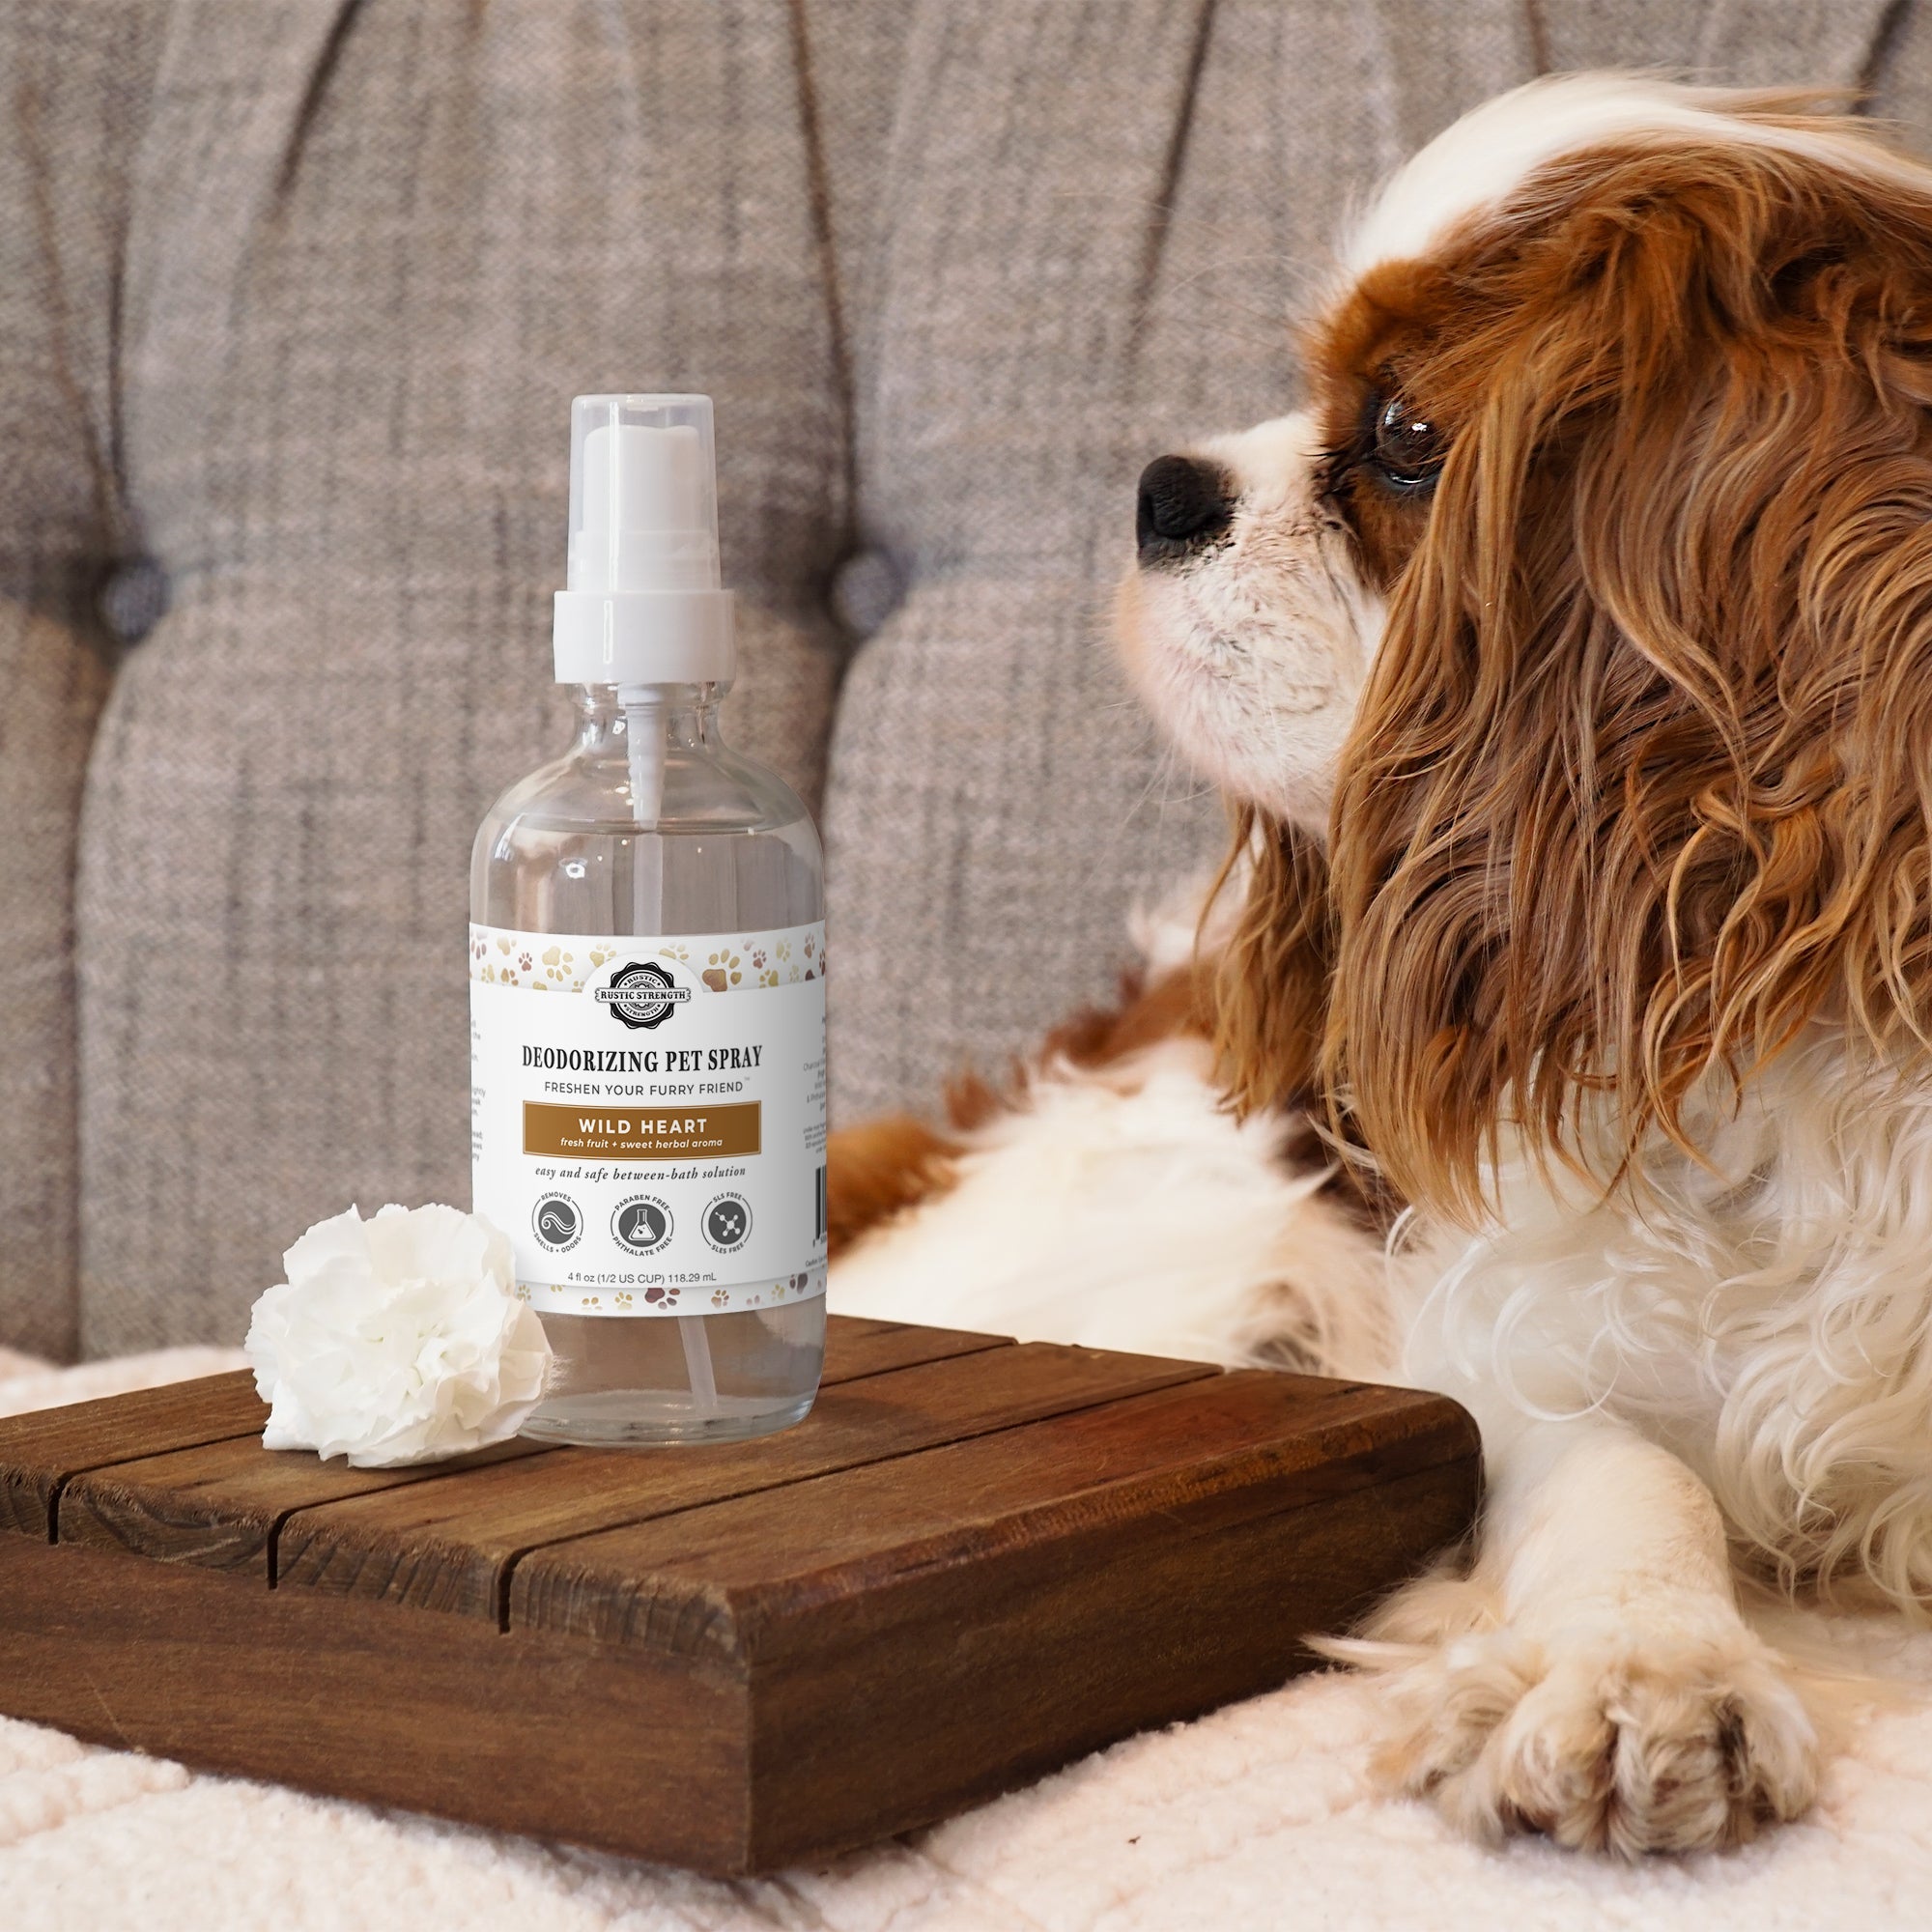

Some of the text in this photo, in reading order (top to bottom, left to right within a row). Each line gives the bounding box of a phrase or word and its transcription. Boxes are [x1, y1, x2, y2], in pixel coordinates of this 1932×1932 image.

[627, 975, 658, 984] RUSTIC
[601, 991, 686, 1000] RUSTIC STRENGTH
[626, 1007, 659, 1016] STRENGTH
[522, 1044, 763, 1073] DEODORIZING PET SPRAY
[545, 1081, 600, 1095] FRESHEN
[605, 1084, 644, 1096] YOUR
[649, 1084, 695, 1096] FURRY
[578, 1118, 707, 1135] WILD HEART
[560, 1137, 584, 1148] fresh
[586, 1138, 610, 1149] fruit
[619, 1140, 653, 1150] sweet
[655, 1138, 690, 1149] herbal
[691, 1139, 724, 1148] aroma
[535, 1165, 746, 1183] easy and safe between-bath solution
[541, 1192, 572, 1203] REMOVES
[615, 1195, 670, 1211] PARABEN FREE
[713, 1192, 743, 1203] SLS FREE
[533, 1232, 582, 1253] SMELLS ODORS
[612, 1236, 672, 1257] PHTHALATE FREE
[711, 1242, 745, 1254] SLES FREE
[567, 1271, 718, 1286] 4 fl oz (1/2 US CUP) 118.29 mL
